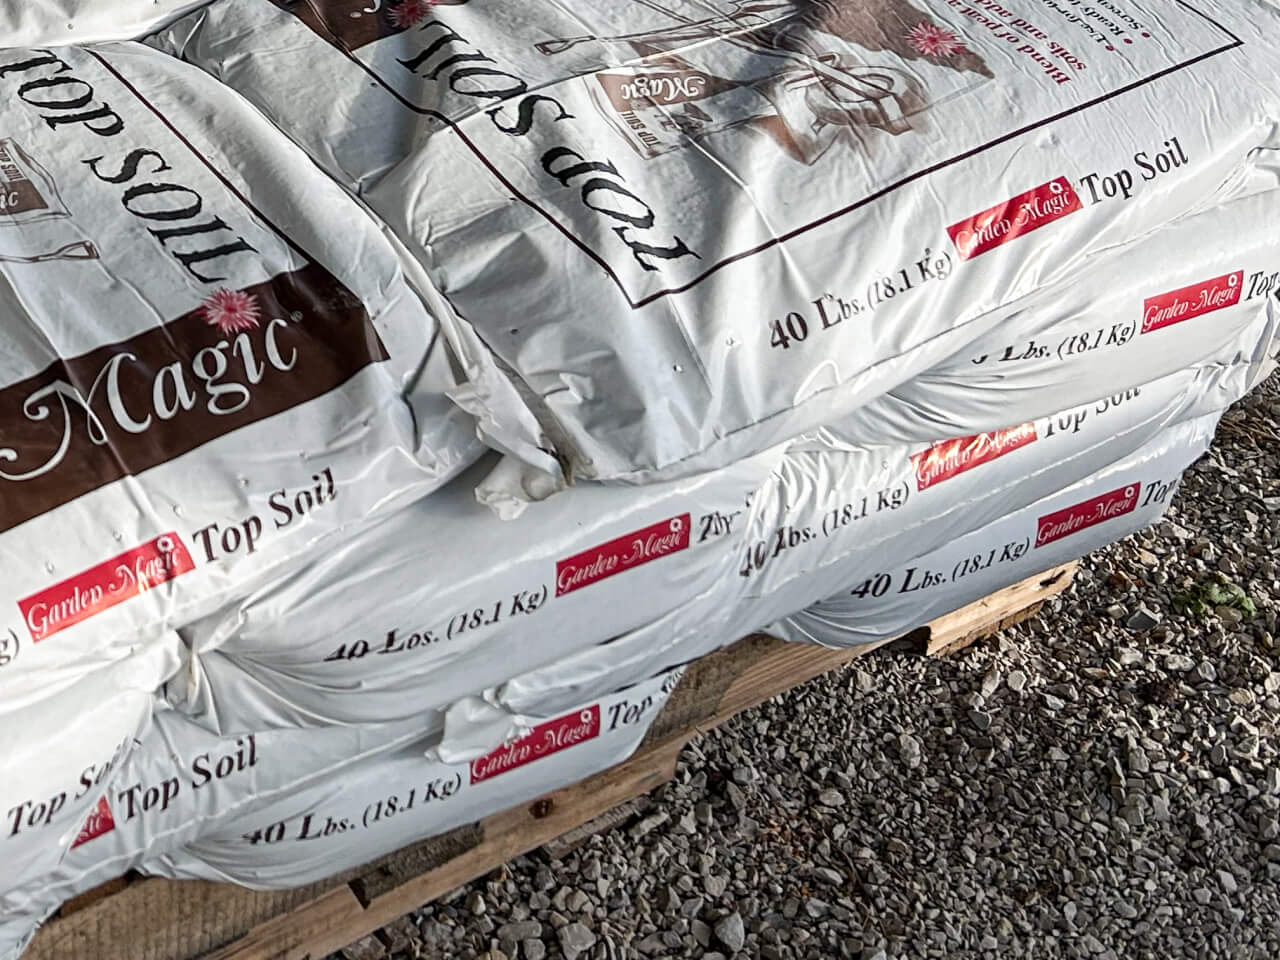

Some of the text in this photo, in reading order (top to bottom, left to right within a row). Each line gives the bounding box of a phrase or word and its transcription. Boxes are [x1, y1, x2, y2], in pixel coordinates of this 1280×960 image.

[621, 76, 705, 102] Magic
[1017, 43, 1072, 85] Blend
[395, 20, 703, 272] TOP SOIL
[1079, 137, 1189, 207] Top Soil
[80, 147, 260, 284] SOIL
[768, 251, 952, 351] 40 Lbs. Kg)
[1143, 283, 1239, 333] Garden Magic
[1056, 320, 1138, 360] (18.1 Kg)
[192, 467, 339, 564] Top Soil
[822, 481, 910, 539] (18.1 Kg)
[1037, 493, 1135, 545] Garden Magic
[557, 529, 687, 592] Garden Magic
[851, 537, 1031, 600] 40 Lbs. (18.1 Kg)
[27, 547, 181, 638] Garden Magic
[446, 584, 549, 641] (18.1 Kg)
[536, 718, 597, 751] Magic
[606, 699, 654, 733] Top
[118, 778, 180, 826] Top
[190, 735, 259, 790] Soil
[294, 773, 462, 842] Lbs. (18.1 Kg)
[7, 791, 68, 840] Top
